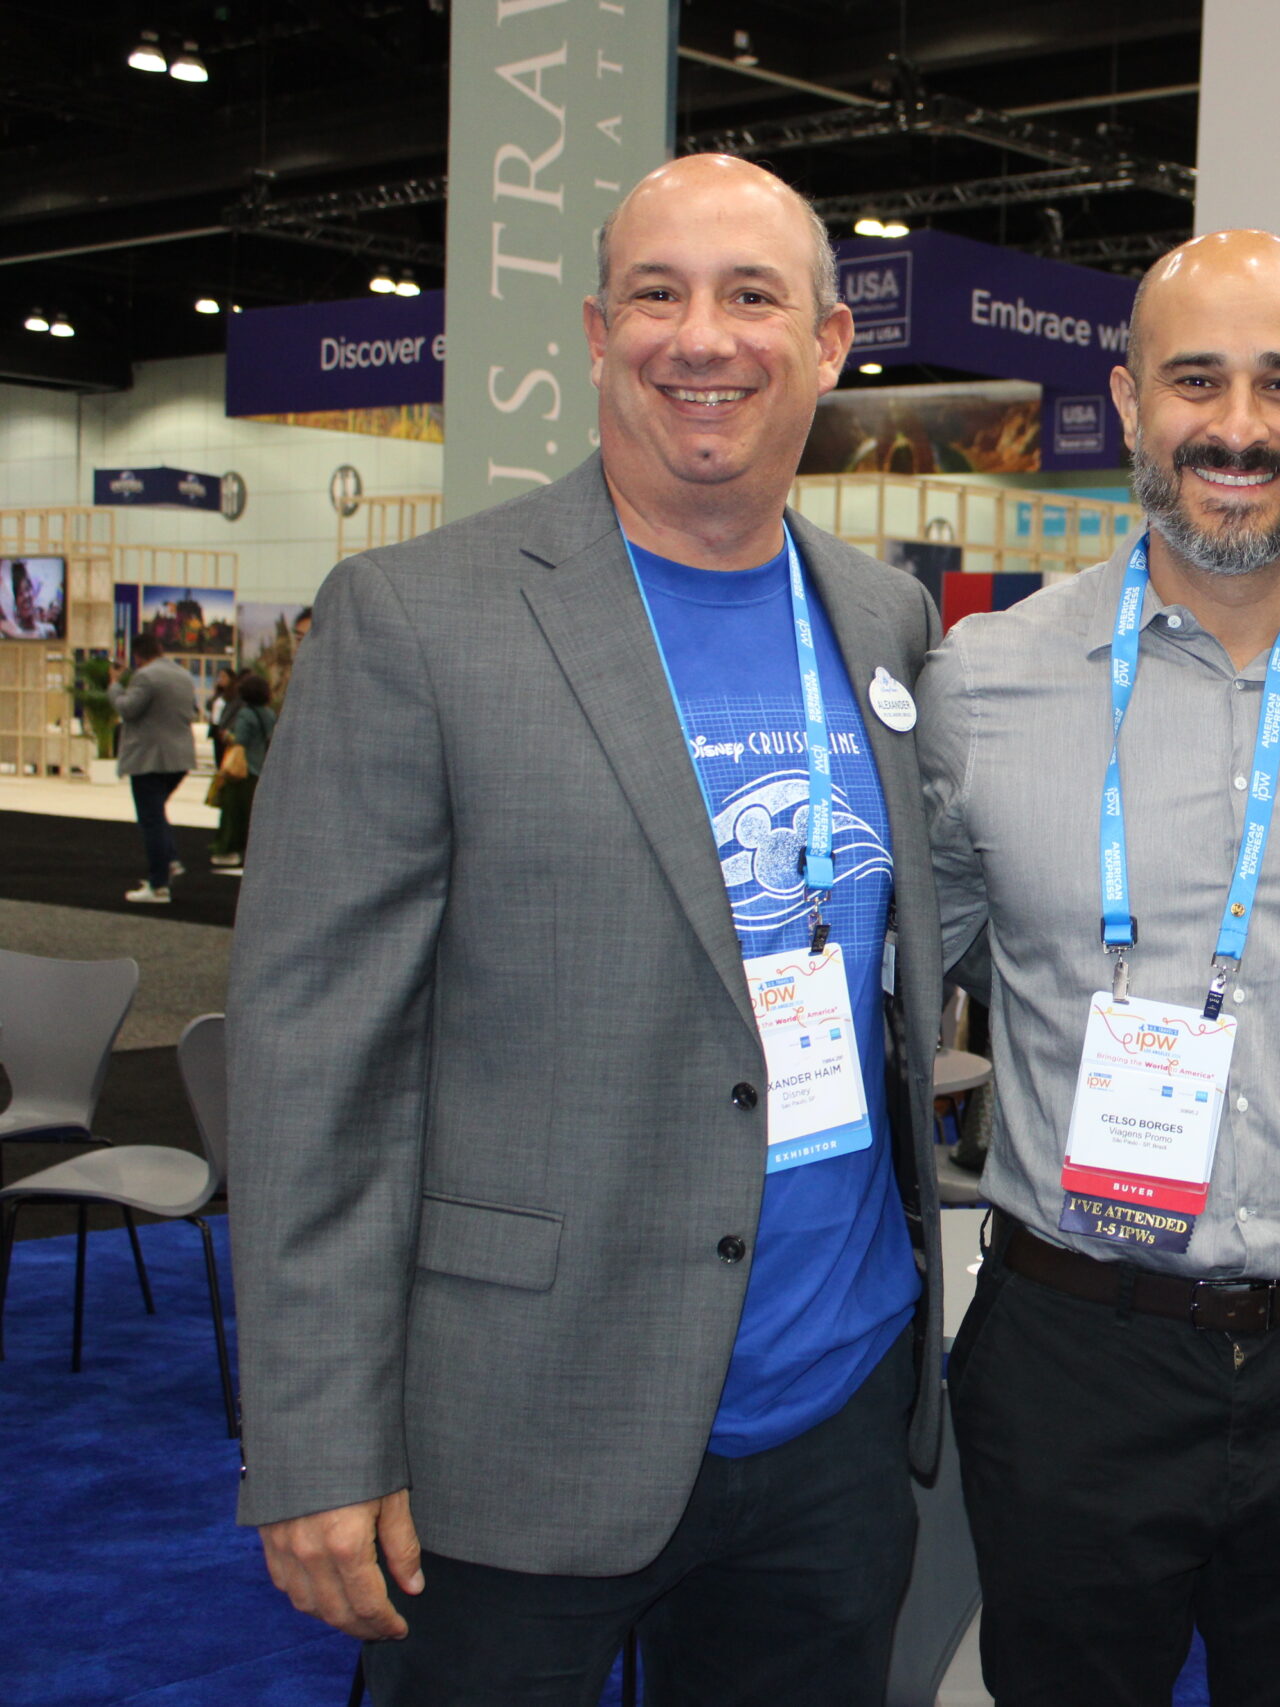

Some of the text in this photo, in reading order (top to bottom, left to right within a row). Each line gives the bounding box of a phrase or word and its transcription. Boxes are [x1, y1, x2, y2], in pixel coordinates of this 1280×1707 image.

[846, 269, 899, 302] USA
[971, 289, 1092, 346] Embrace
[320, 335, 425, 372] Discover
[1118, 587, 1133, 636] AMERICAN
[1127, 586, 1140, 630] EXPRESS
[1119, 659, 1131, 687] ipw
[1261, 692, 1277, 749] AMERICAN
[828, 732, 861, 755] INE
[1258, 771, 1273, 802] ipw
[1105, 787, 1117, 817] ipw
[1239, 822, 1257, 880] AMERICAN
[1248, 824, 1265, 875] EXPRESS
[1104, 849, 1116, 900] EXPRESS
[1111, 841, 1123, 900] AMERICAN
[760, 984, 795, 1011] ipw
[776, 1015, 798, 1024] World
[1136, 1031, 1178, 1052] ipw
[815, 1064, 842, 1079] HAIM
[1096, 1052, 1129, 1065] Bringing
[1145, 1062, 1169, 1071] World
[1101, 1113, 1184, 1134] CELSO BORGES
[1109, 1127, 1173, 1144] Viagens Promo
[775, 1140, 838, 1163] EXHIBITOR
[1113, 1183, 1154, 1197] BUYER
[1069, 1197, 1188, 1234] I'VE ATTENDED
[1095, 1220, 1156, 1245] 1-5 IPWs
